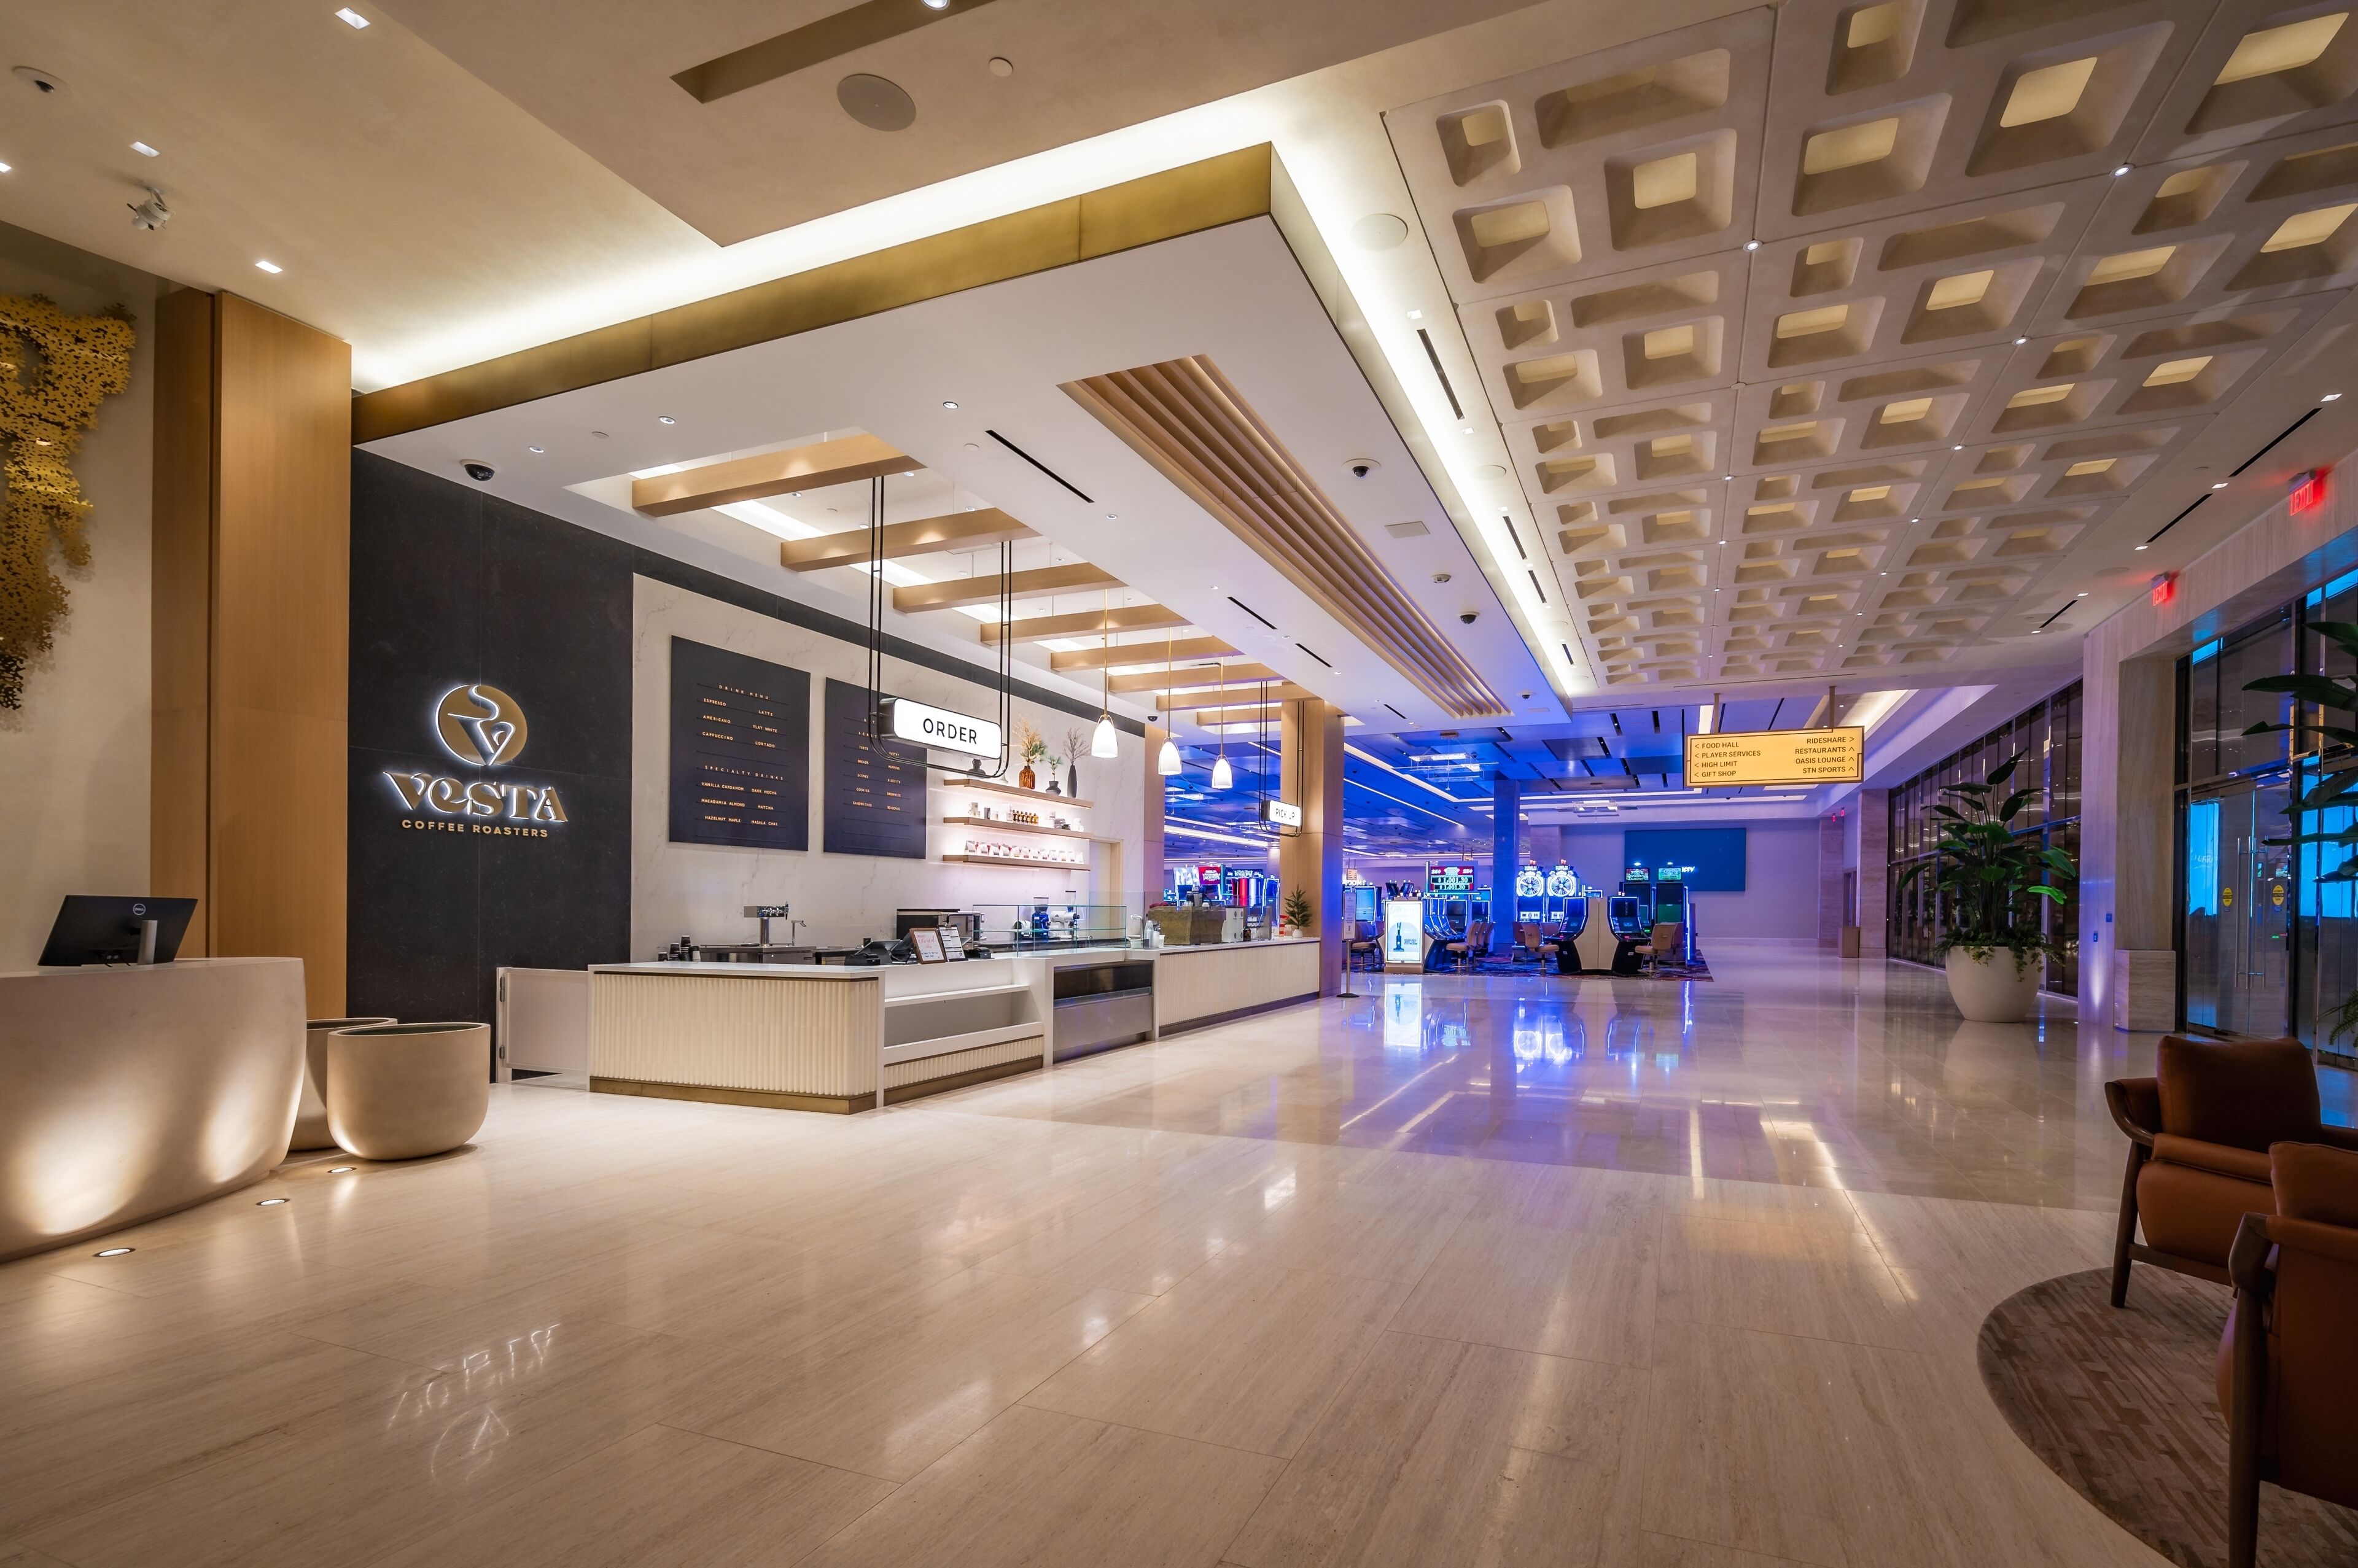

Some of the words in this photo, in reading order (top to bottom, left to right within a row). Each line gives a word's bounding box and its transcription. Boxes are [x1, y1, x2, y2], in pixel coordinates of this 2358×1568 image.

[719, 685, 744, 694] DRINK
[702, 715, 731, 724] AMERICANO
[702, 731, 733, 740] CAPPUCCINO
[923, 718, 977, 745] ORDER
[704, 765, 750, 775] SPECIALTY
[1275, 808, 1287, 818] PICK
[402, 819, 465, 833] COFFEE
[472, 824, 548, 838] ROASTERS
